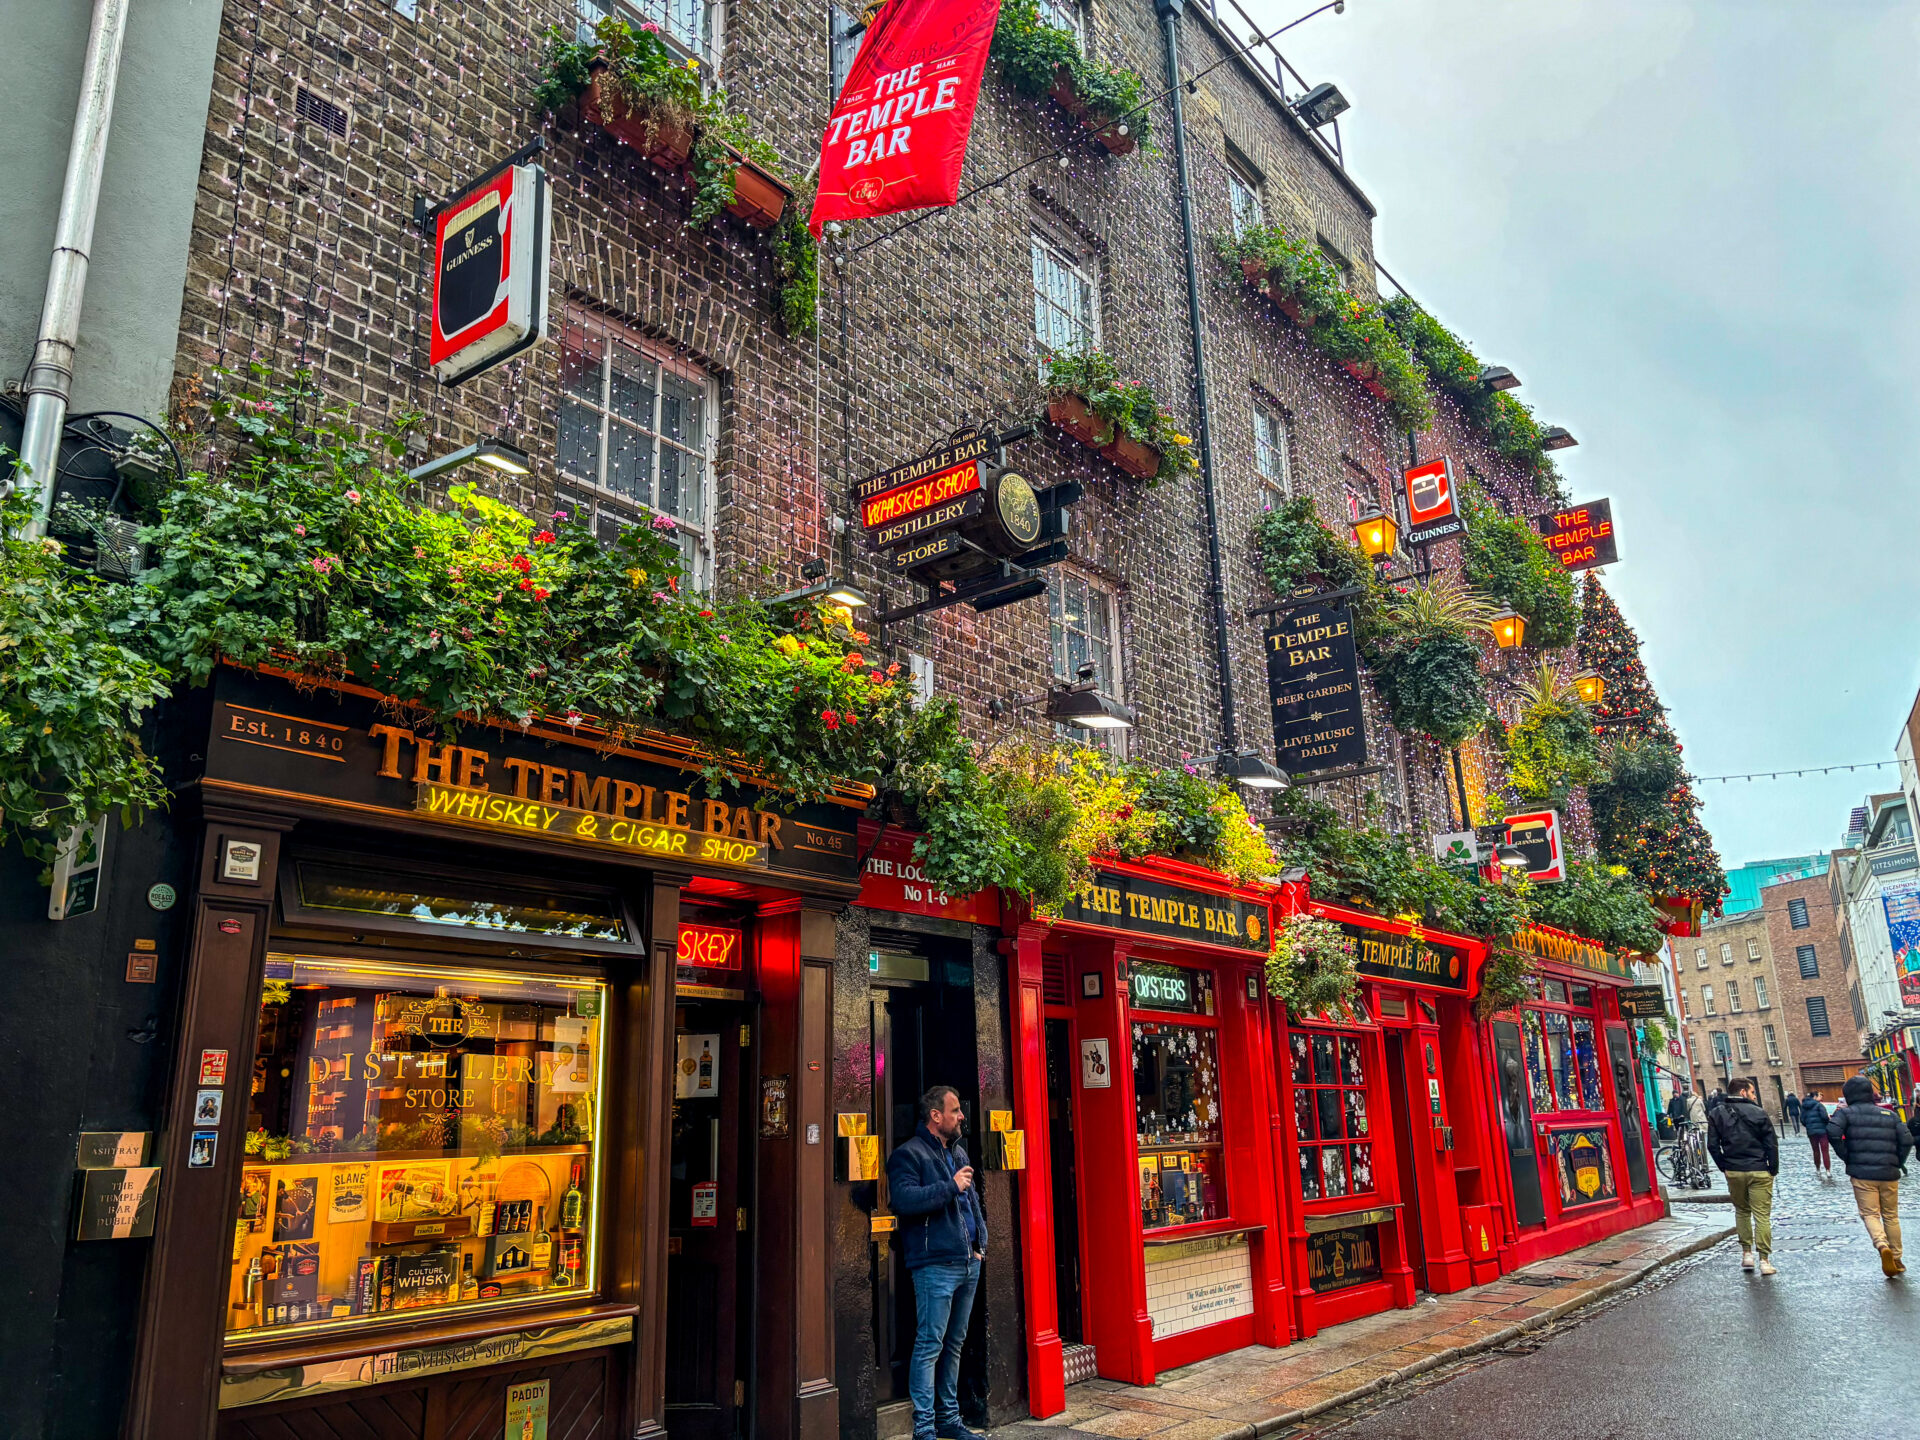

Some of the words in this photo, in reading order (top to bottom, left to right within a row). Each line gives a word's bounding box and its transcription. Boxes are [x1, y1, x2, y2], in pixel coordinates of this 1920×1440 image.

[936, 58, 957, 70] MARK
[873, 62, 924, 100] THE
[828, 76, 961, 147] TEMPLE
[842, 125, 912, 170] BAR
[855, 185, 878, 199] 1840
[446, 235, 493, 272] GUINNESS
[858, 478, 888, 497] THE
[890, 452, 951, 487] TEMPLE
[955, 439, 989, 462] BAR
[867, 484, 934, 526] WHISKEY
[934, 466, 976, 500] SHOP
[878, 500, 968, 544] DISTILLERY
[1010, 512, 1031, 532] 1840
[1554, 509, 1588, 528] THE
[1409, 522, 1459, 543] GUINNESS
[1543, 521, 1611, 550] TEMPLE
[897, 538, 948, 566] STORE
[1561, 546, 1596, 565] BAR
[1293, 613, 1321, 628] THE
[1269, 622, 1349, 651] TEMPLE
[1289, 646, 1332, 667] BAR
[1276, 692, 1304, 706] BEER
[1306, 682, 1353, 700] GARDEN
[229, 714, 275, 739] Est.
[285, 728, 343, 751] 1840
[1284, 734, 1312, 748] LIVE
[1313, 726, 1355, 743] MUSIC
[1301, 742, 1339, 759] DAILY
[368, 723, 489, 791] THE
[503, 757, 691, 831] TEMPLE
[703, 797, 784, 850] BAR
[430, 787, 560, 830] WHISKEY
[576, 814, 597, 838] &
[610, 822, 687, 854] CIGAR
[701, 838, 757, 863] SHOP
[806, 831, 826, 847] No.
[827, 836, 842, 850] 45
[1515, 838, 1545, 846] GUINNESS
[866, 858, 893, 876] THE
[1872, 855, 1917, 870] FITZSIMONS
[151, 893, 172, 901] ROE&CO
[904, 885, 922, 901] No
[927, 888, 948, 906] 1-6
[1081, 882, 1122, 915] THE
[1126, 892, 1199, 929] TEMPLE
[1204, 907, 1239, 936] BAR
[677, 931, 735, 963] SKEY
[1362, 939, 1414, 970] TEMPLE
[1416, 949, 1441, 975] BAR
[1512, 929, 1535, 953] THE
[1537, 931, 1585, 965] TEMPLE
[1588, 944, 1608, 972] BAR
[1135, 974, 1186, 1001] OYSTERS
[429, 1017, 464, 1034] THE
[308, 1051, 562, 1086] DISTILLERY
[762, 1080, 787, 1089] WHISKEY
[404, 1088, 476, 1109] STORE
[93, 1147, 139, 1155] ASHTRAY
[112, 1182, 134, 1191] THE
[335, 1173, 366, 1186] SLANE
[100, 1193, 144, 1202] TEMPLE
[108, 1205, 131, 1214] BAR
[97, 1216, 140, 1226] DUBLIN
[1314, 1238, 1324, 1248] THE
[1351, 1240, 1374, 1270] D.W.D.
[399, 1273, 451, 1288] WHISKY
[408, 1267, 443, 1276] CULTURE
[363, 1274, 371, 1306] TEMPLE
[1195, 1288, 1208, 1298] Walrus
[1209, 1286, 1217, 1296] and
[1199, 1301, 1210, 1311] down
[381, 1355, 409, 1376] THE
[417, 1345, 479, 1369] WHISKEY
[485, 1339, 519, 1358] SHOP
[512, 1385, 545, 1402] PADDY
